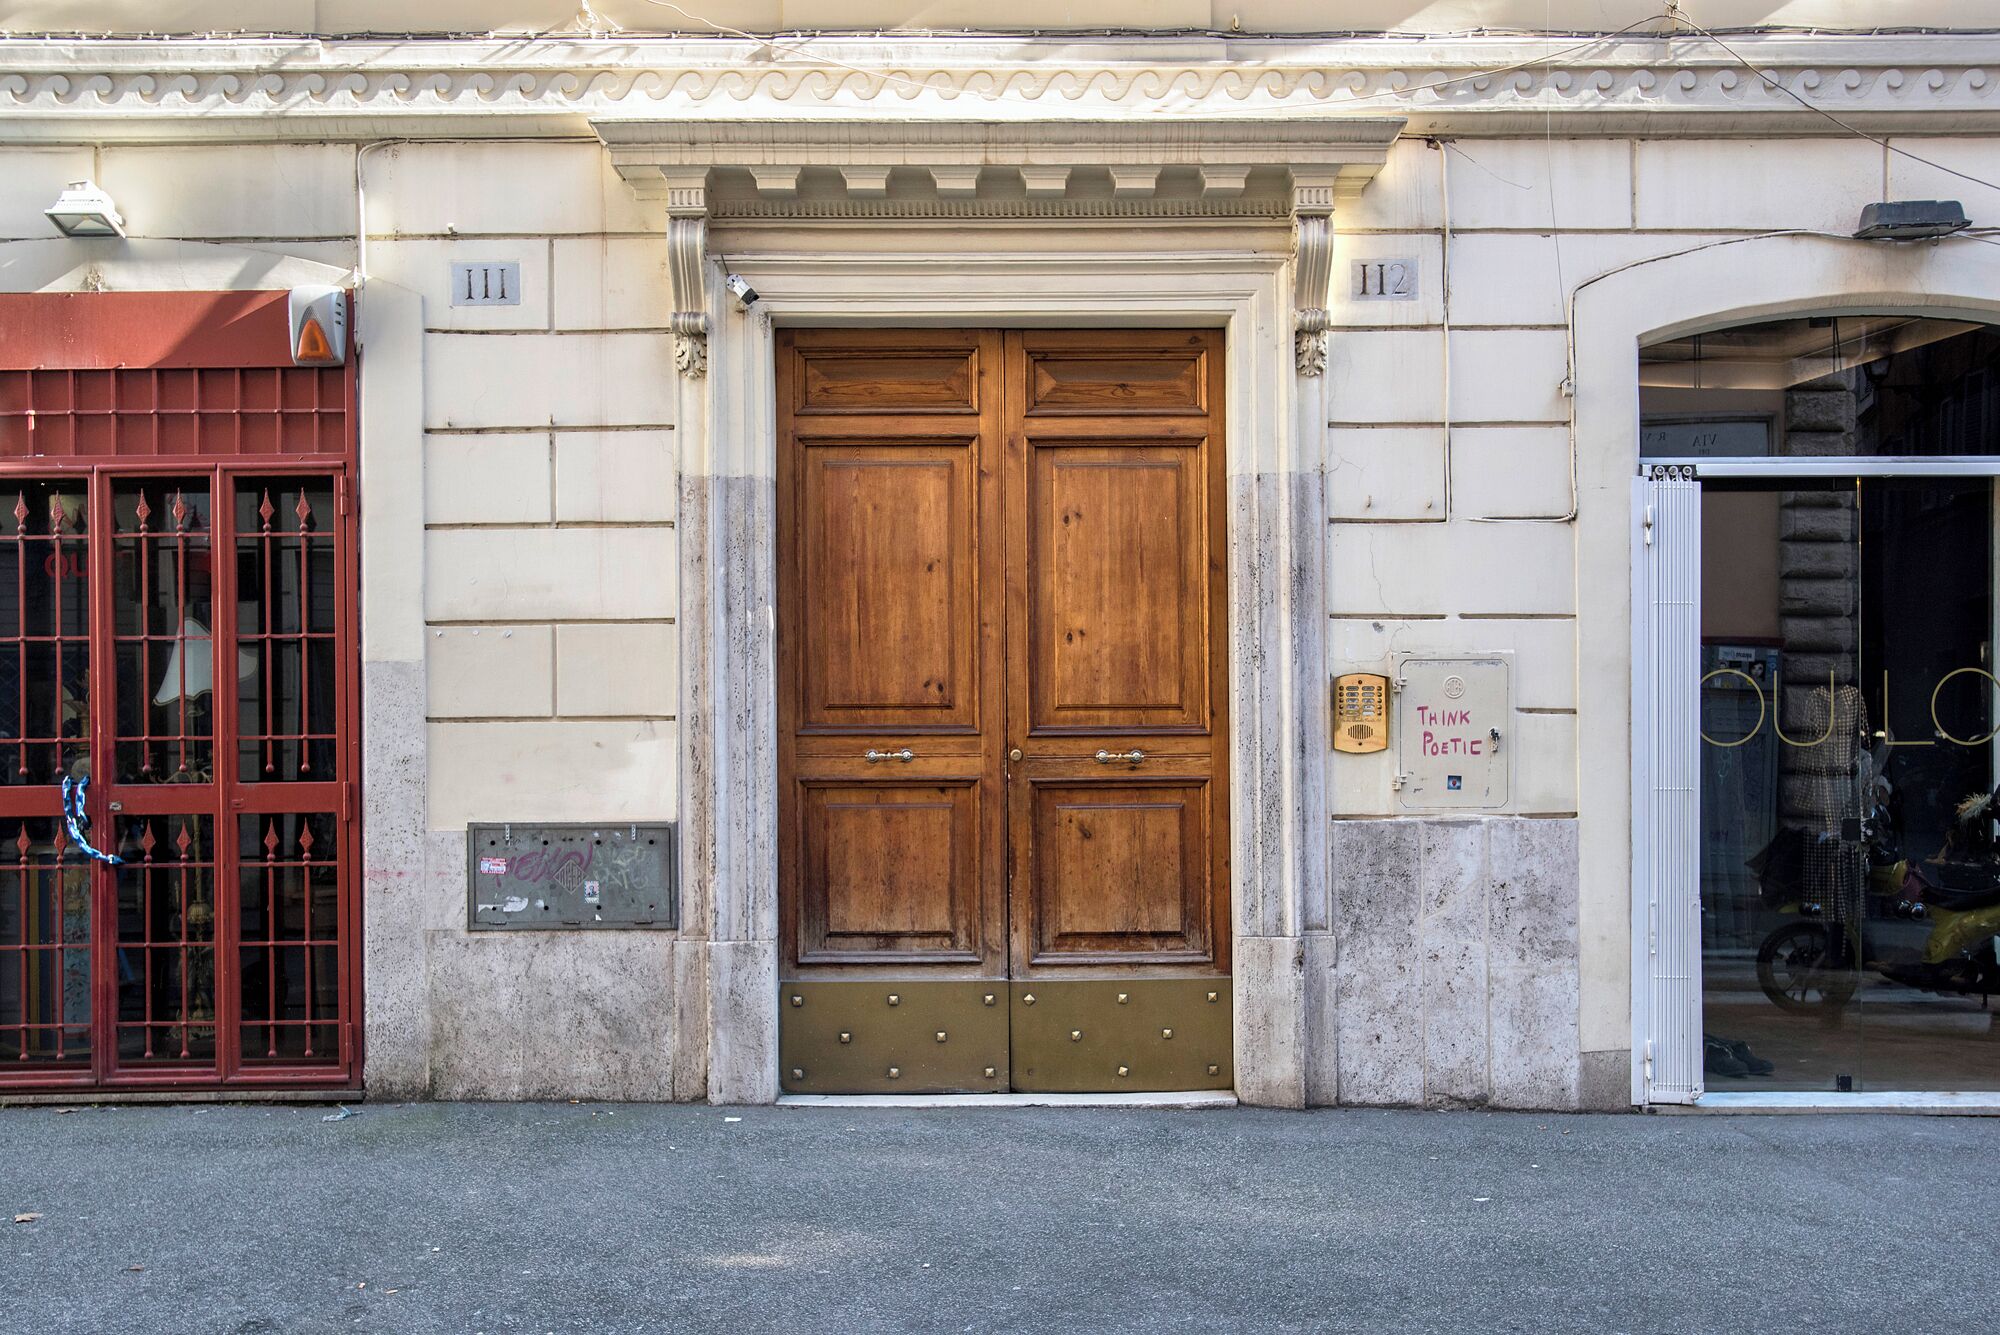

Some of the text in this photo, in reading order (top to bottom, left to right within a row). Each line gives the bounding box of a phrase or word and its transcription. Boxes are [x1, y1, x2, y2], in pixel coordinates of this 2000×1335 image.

[1360, 264, 1408, 296] 112
[1417, 706, 1471, 727] THINK
[1422, 731, 1483, 756] POETIC
